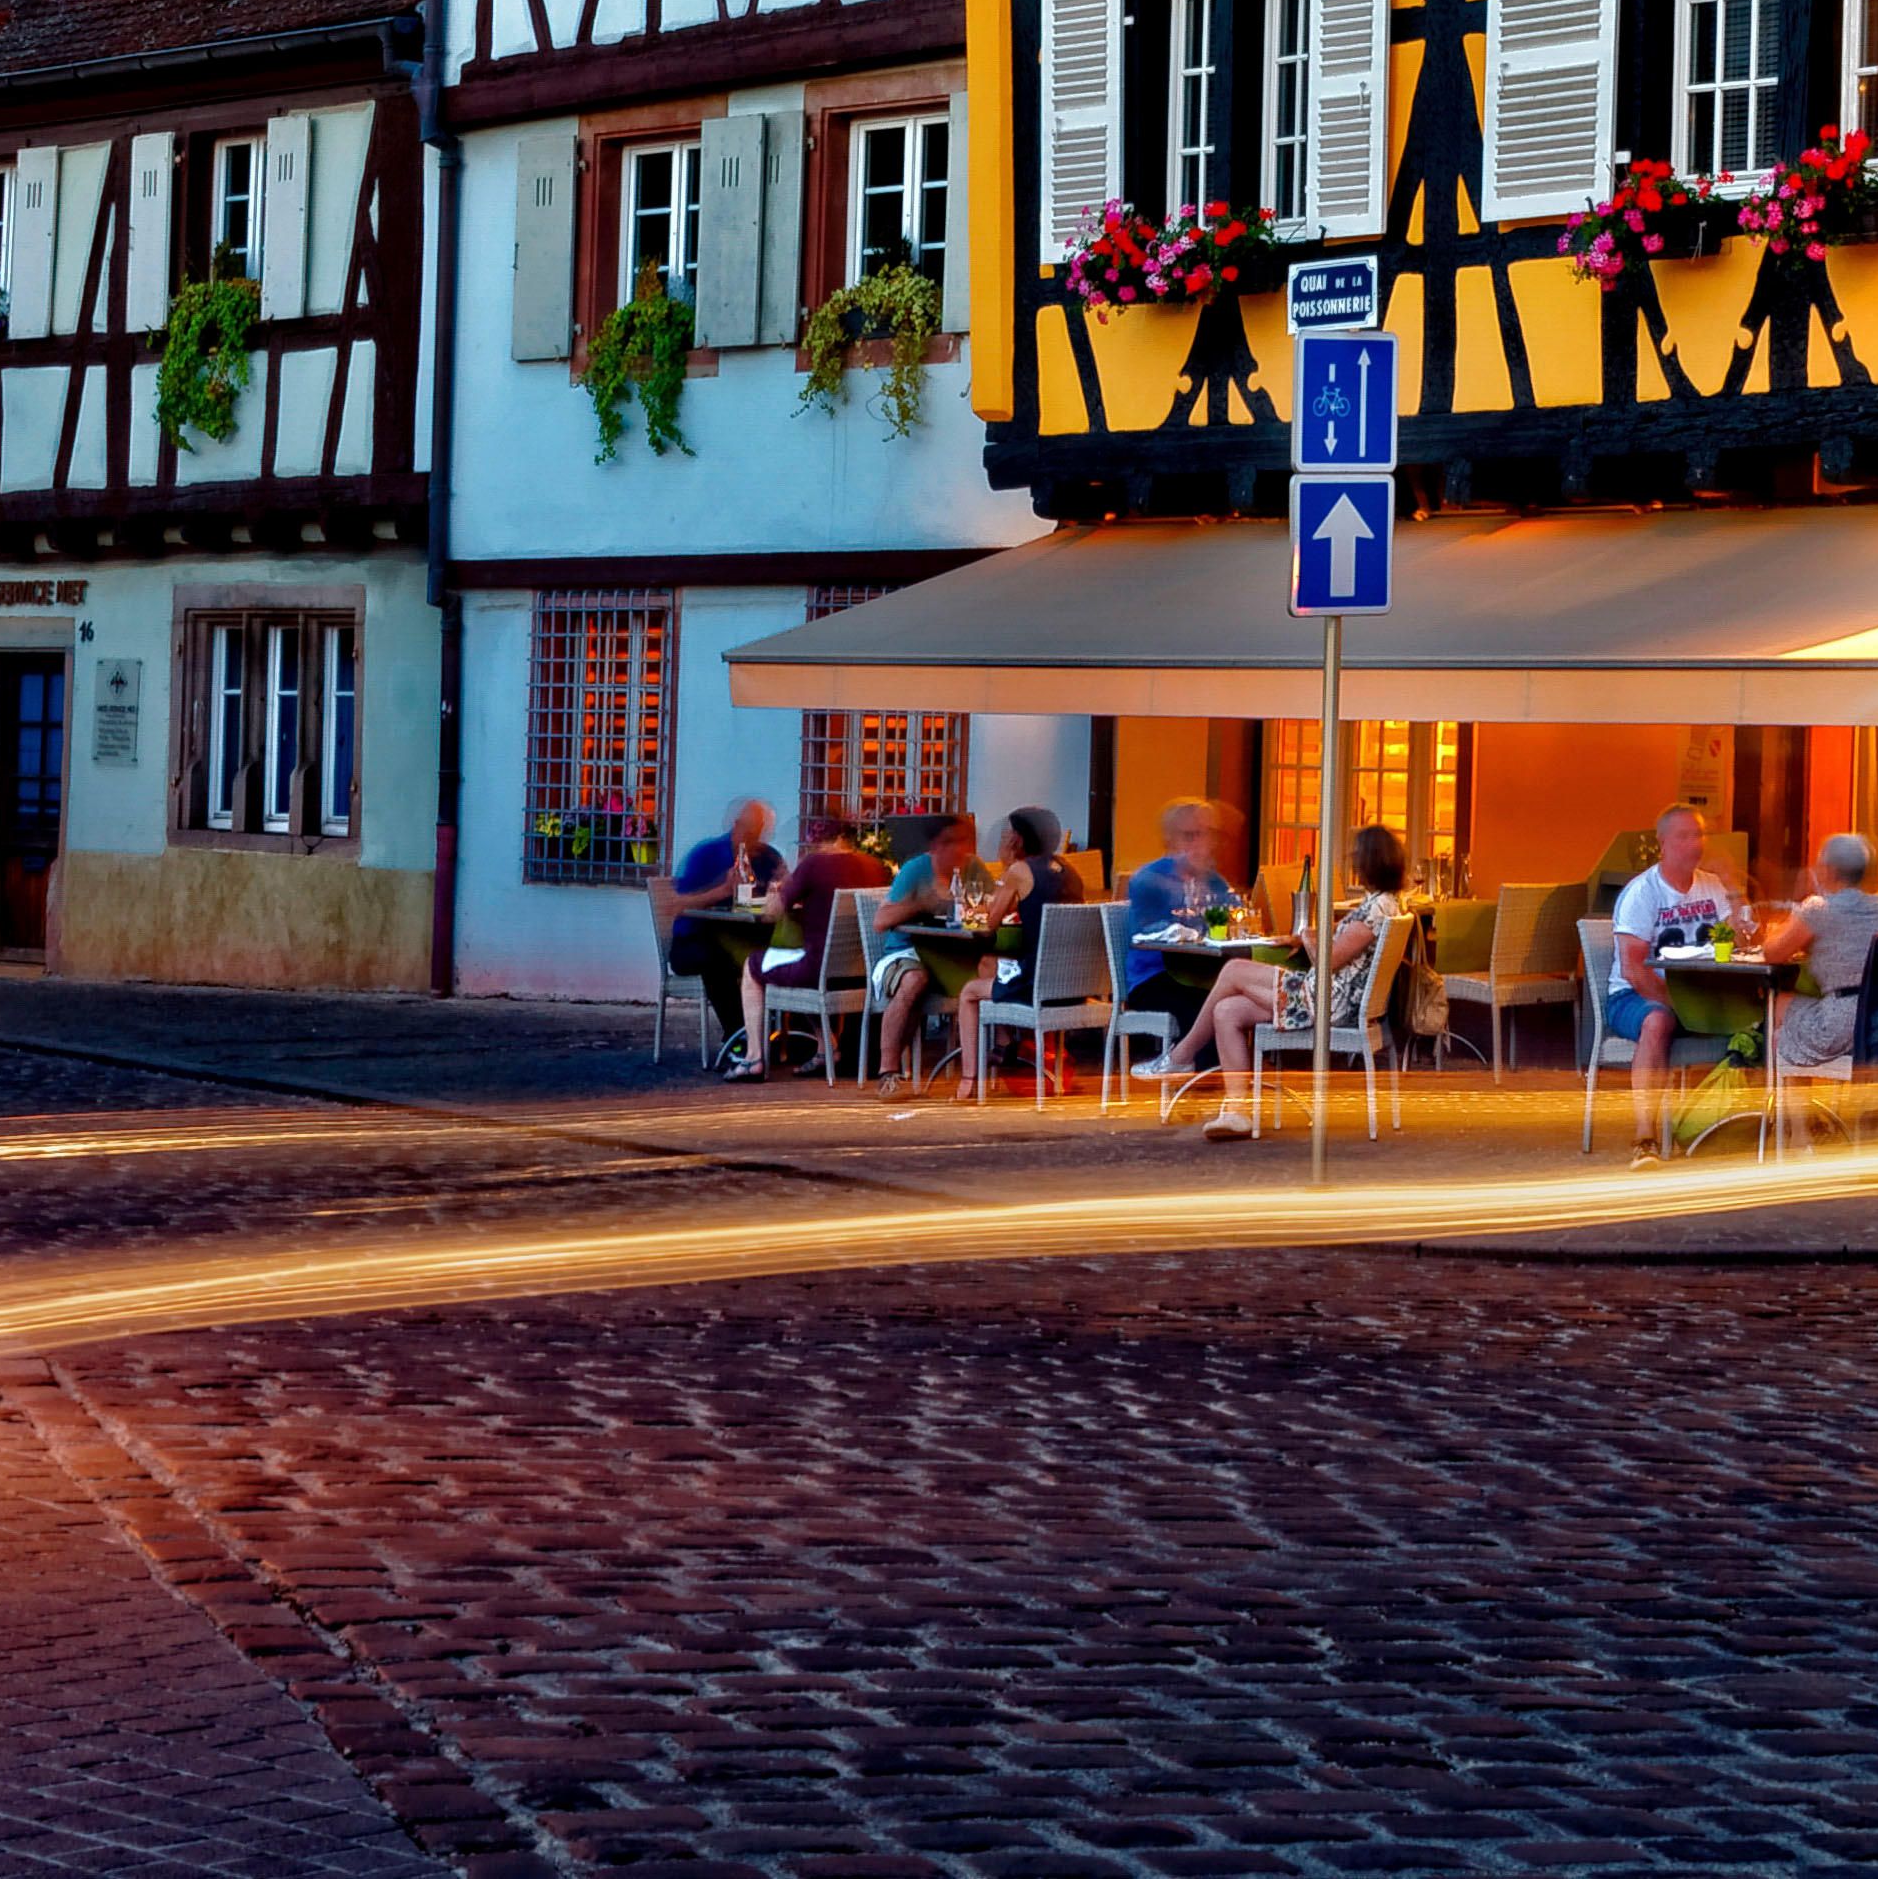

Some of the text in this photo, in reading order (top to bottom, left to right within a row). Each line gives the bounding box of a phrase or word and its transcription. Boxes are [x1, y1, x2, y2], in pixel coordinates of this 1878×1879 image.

[1300, 273, 1363, 293] QUAI DE LA
[1292, 294, 1371, 319] POISSONNERIE
[79, 621, 95, 643] 16
